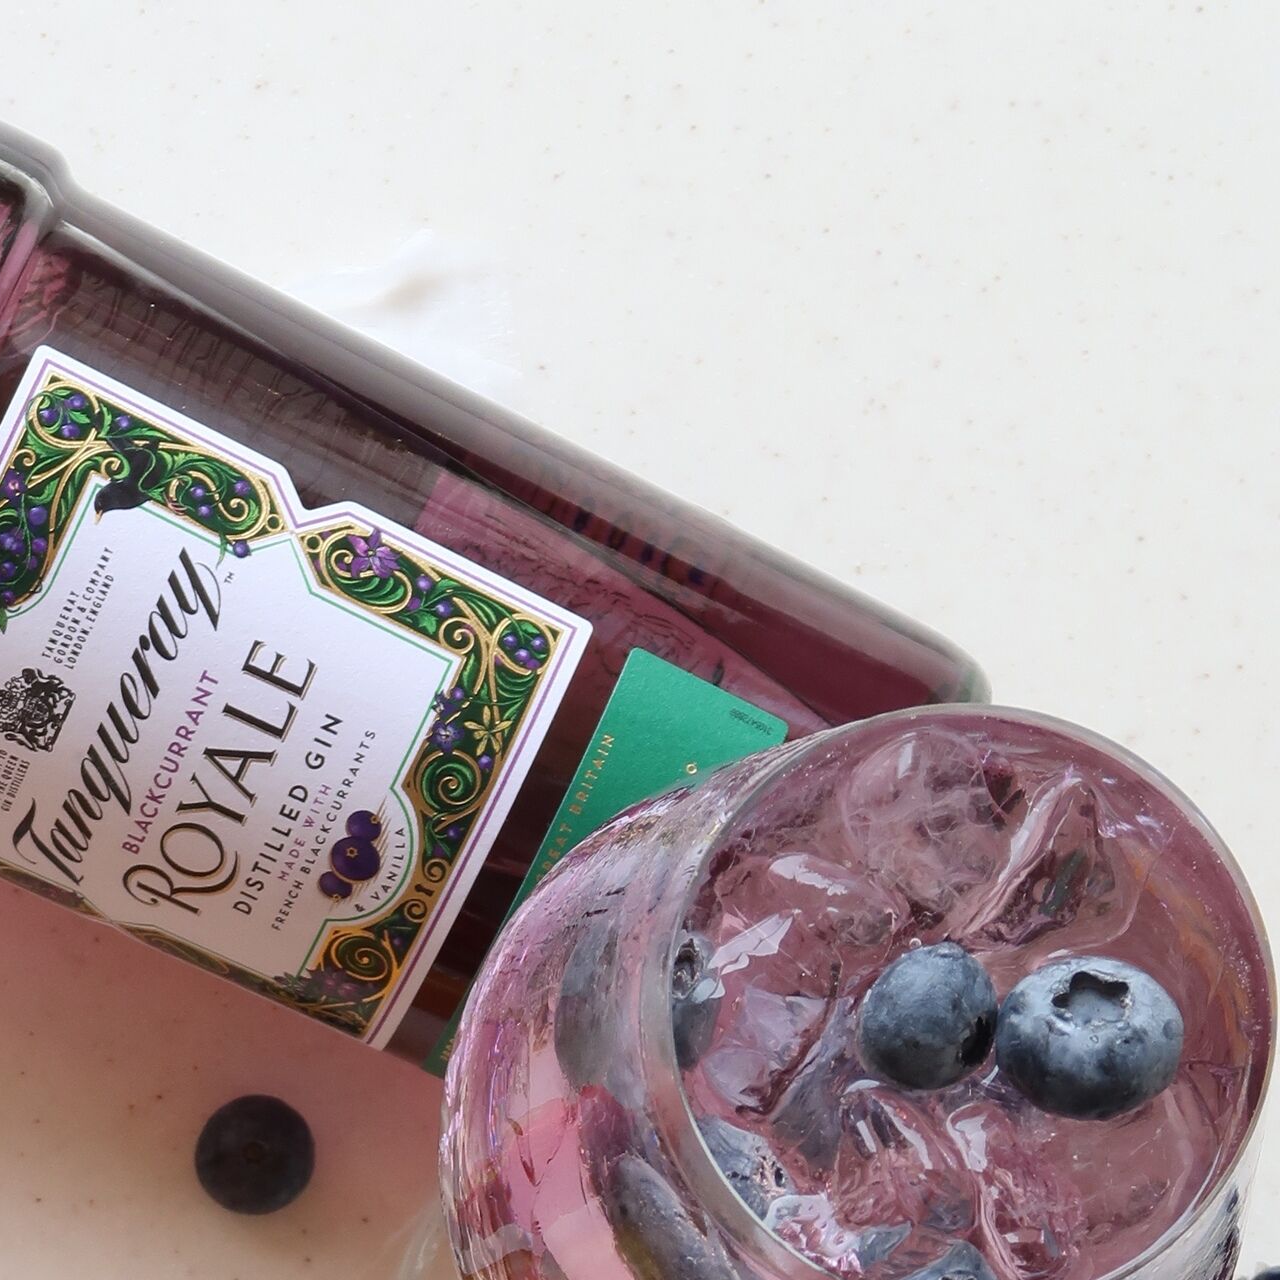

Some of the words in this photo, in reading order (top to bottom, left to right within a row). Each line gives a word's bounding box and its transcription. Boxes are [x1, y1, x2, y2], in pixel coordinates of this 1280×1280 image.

[41, 591, 84, 658] TANQUERAY
[53, 617, 81, 664] GORDON
[82, 547, 113, 601] COMPANY
[85, 575, 114, 623] ENGLAND
[12, 547, 221, 886] Tanqueray
[122, 668, 219, 855] BLACKCURRANT
[1, 755, 19, 780] QUEEN
[6, 760, 30, 798] DISTILLERS
[122, 640, 318, 918] ROYALE
[232, 783, 308, 916] DISTILLED
[305, 714, 343, 770] GIN
[569, 734, 615, 815] BRITAIN
[271, 880, 304, 931] FRENCH
[295, 728, 377, 878] BLACKCURRANTS
[277, 838, 306, 882] MADE
[301, 783, 331, 828] WITH
[370, 827, 406, 901] VANILLA
